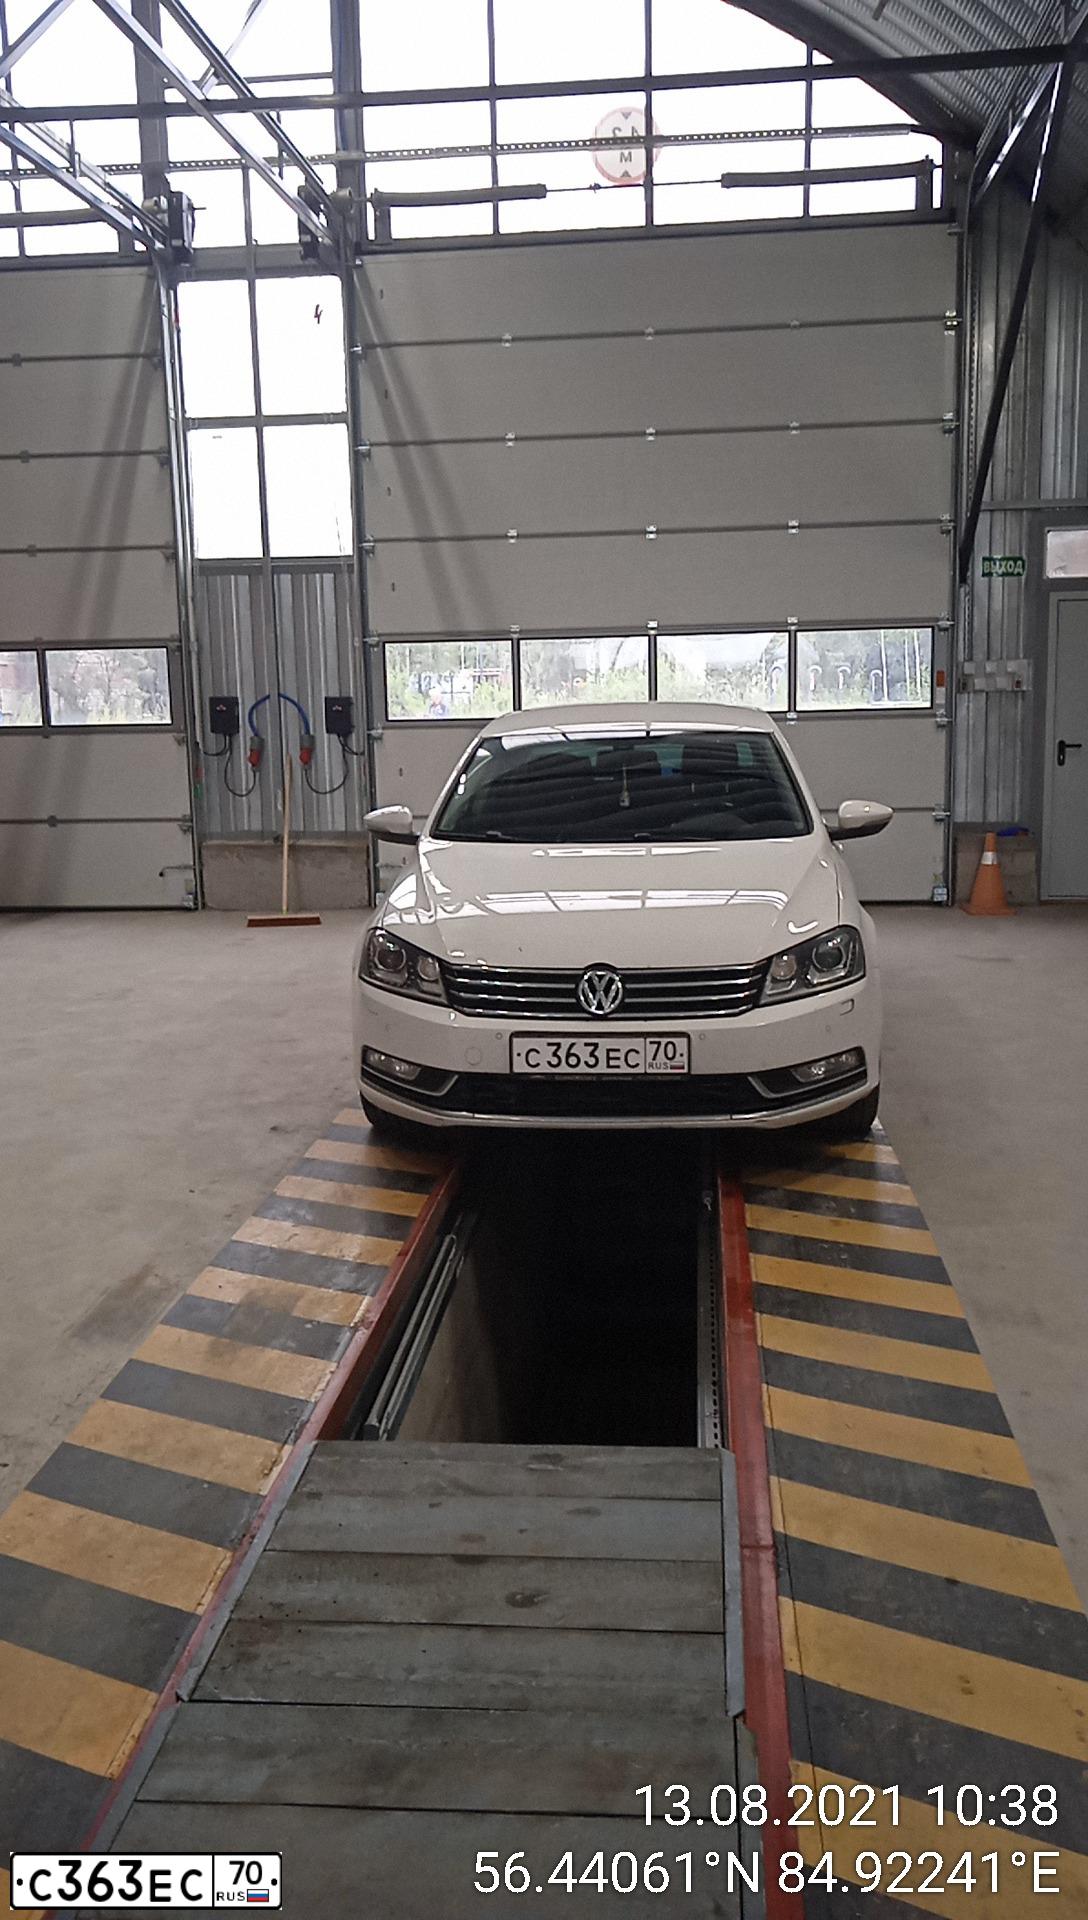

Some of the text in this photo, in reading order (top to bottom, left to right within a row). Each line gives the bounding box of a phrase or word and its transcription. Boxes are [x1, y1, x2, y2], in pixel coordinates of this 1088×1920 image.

[983, 560, 1024, 575] ВЫХОД
[649, 1040, 677, 1061] 70
[648, 1062, 669, 1070] RUS
